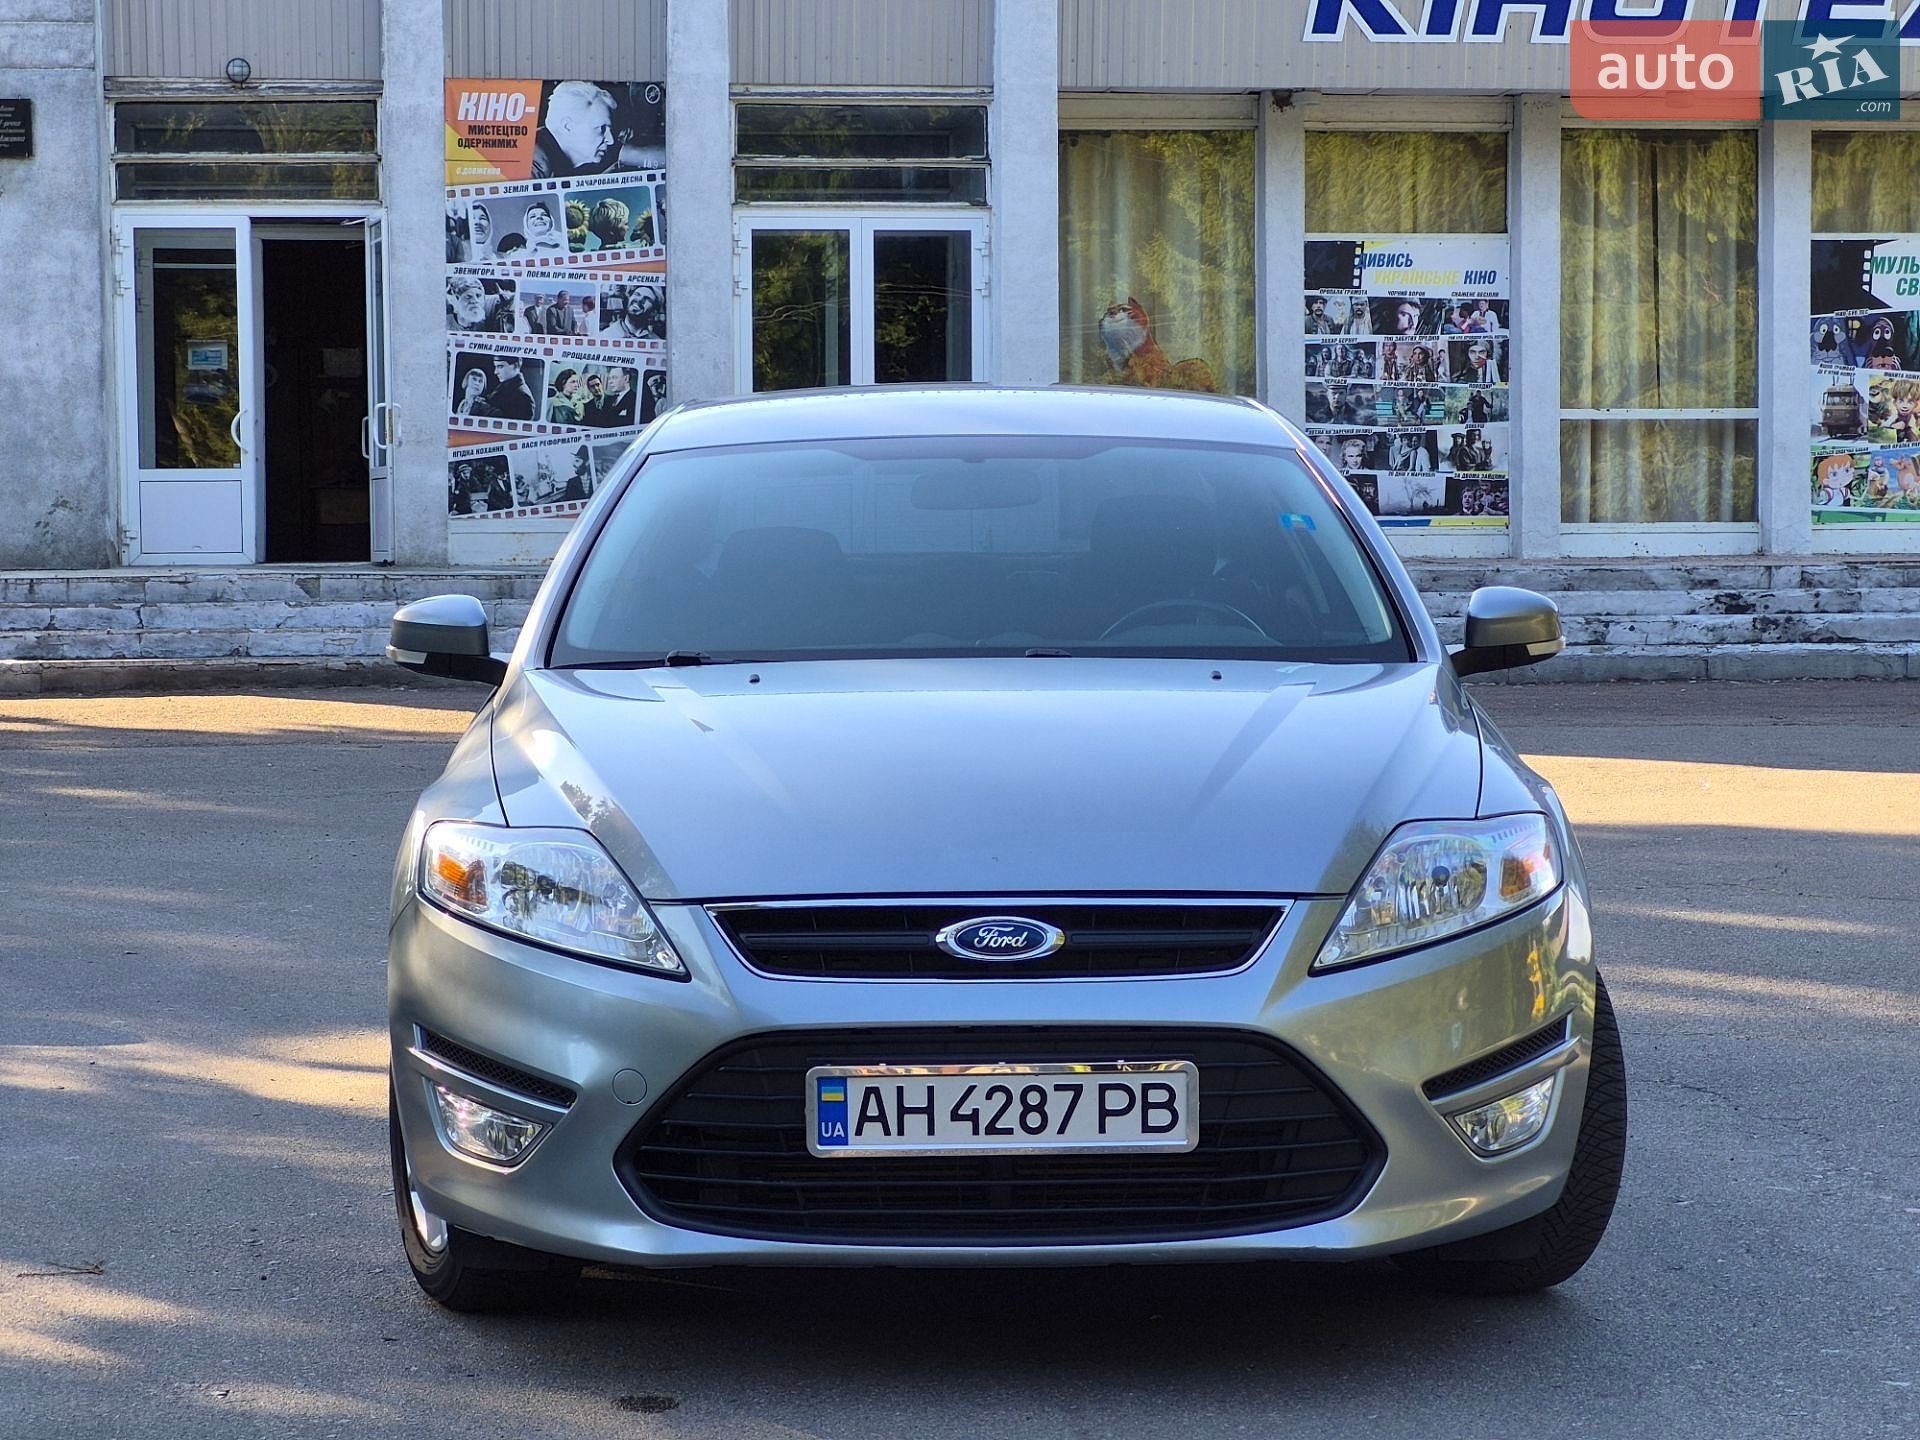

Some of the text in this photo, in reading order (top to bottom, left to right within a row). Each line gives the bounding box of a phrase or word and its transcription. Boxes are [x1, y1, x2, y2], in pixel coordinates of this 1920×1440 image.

[458, 92, 536, 122] КІНО-
[468, 125, 528, 137] МИСТЕЦТВО
[457, 137, 518, 149] ОДЕРЖИМИХ
[575, 175, 643, 188] ЗАЧАРОВАНА ДЕСНА
[503, 184, 529, 194] ЗЕМЛЯ
[1359, 253, 1414, 268] ДИВИСЬ
[453, 266, 495, 276] ЗВЕНИГОРА
[526, 270, 588, 281] ПОЕМА ПРО МОРЕ
[1374, 267, 1497, 285] УКРАЇНСЬКЕ КІНО
[1896, 277, 1920, 296] СВ
[469, 342, 493, 351] СУМКА
[561, 350, 601, 361] ПРОЩАВАЙ
[521, 436, 582, 449] ВАСЯ РЕФОРМАТОР
[973, 926, 1027, 949] Ford
[854, 1082, 1180, 1137] AH 4287 PB
[821, 1121, 845, 1138] UA
